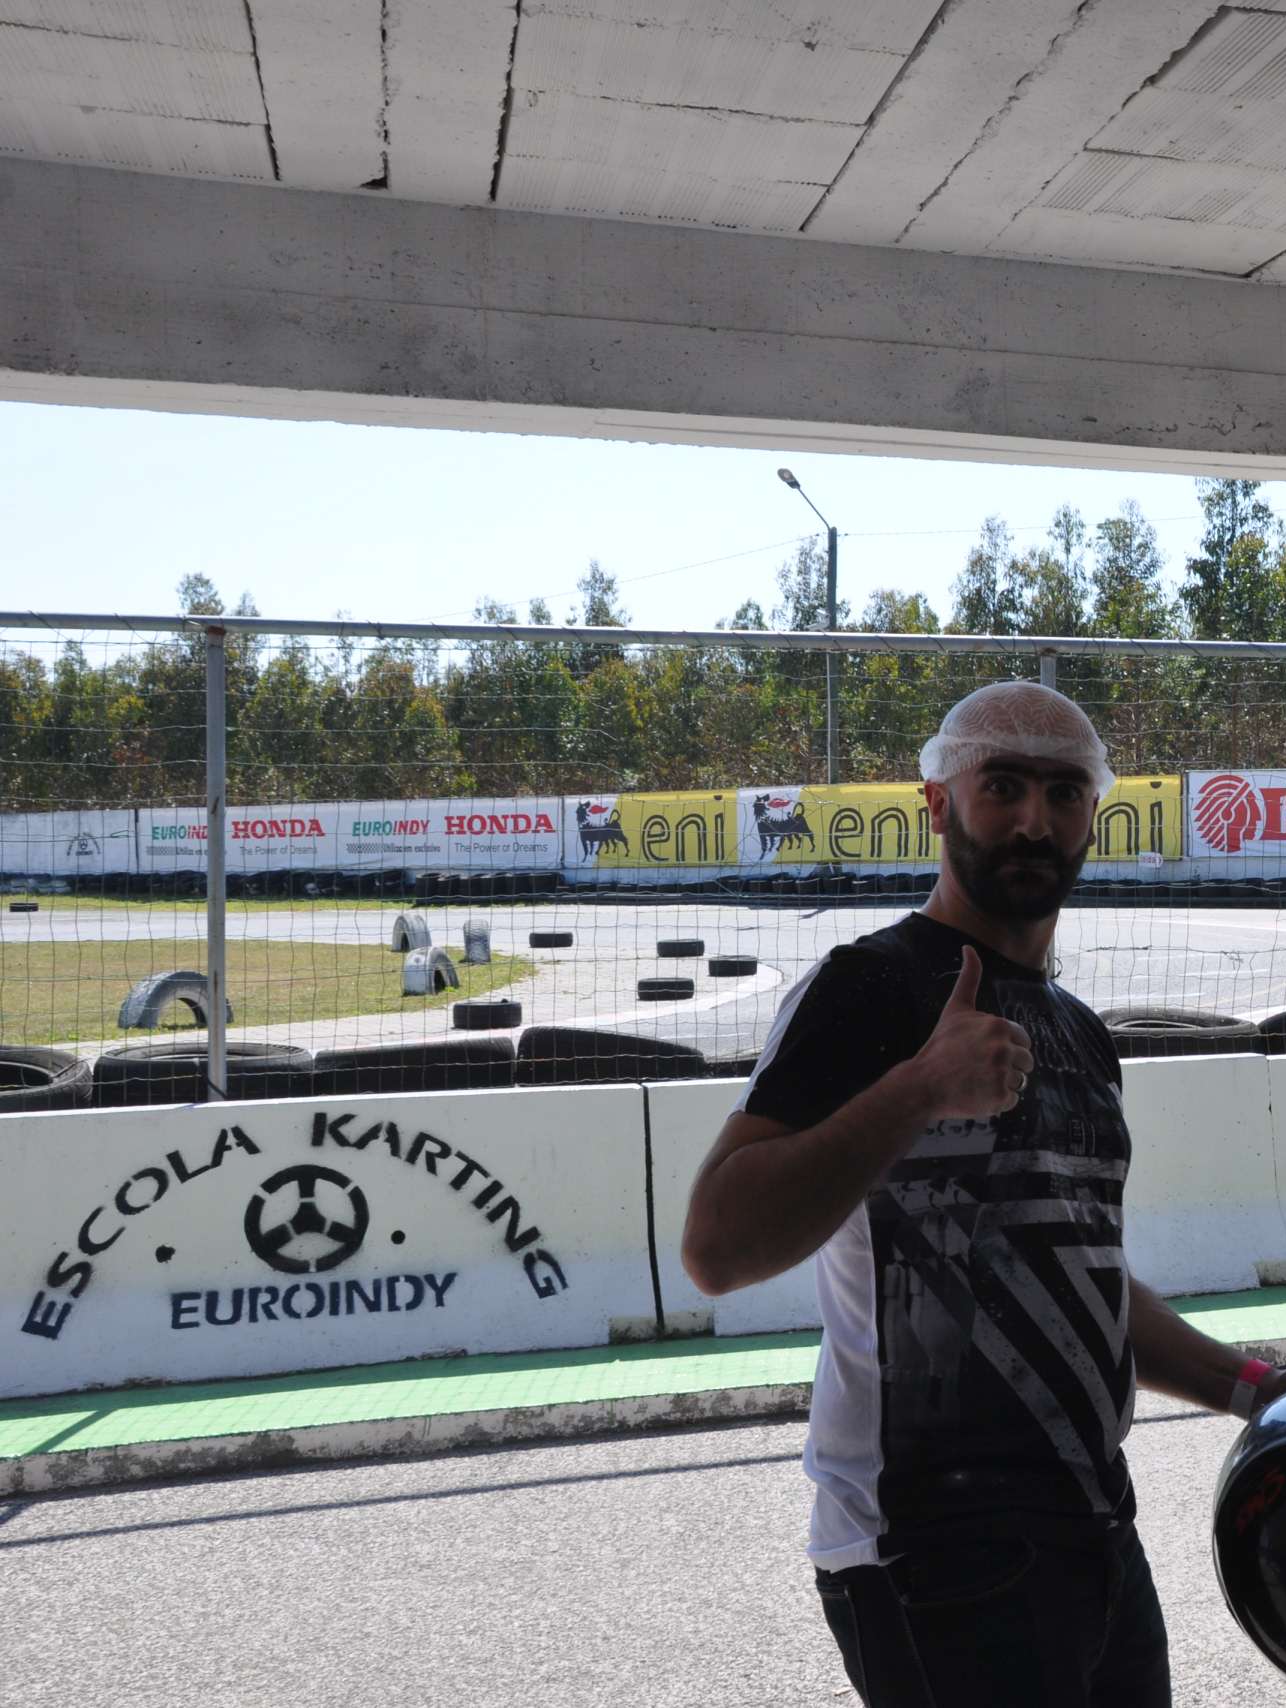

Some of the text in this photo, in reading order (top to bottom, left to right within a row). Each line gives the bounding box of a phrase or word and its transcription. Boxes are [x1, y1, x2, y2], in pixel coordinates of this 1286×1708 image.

[151, 819, 326, 841] EUROIND HONDA
[352, 814, 556, 837] EUROINDY HONDA
[473, 842, 502, 853] Power
[512, 841, 549, 853] Dreams
[642, 795, 725, 862] eni
[1099, 781, 1163, 856] ni
[21, 1112, 569, 1341] ESCOLA KARTING
[170, 1272, 458, 1330] EUROINDY
